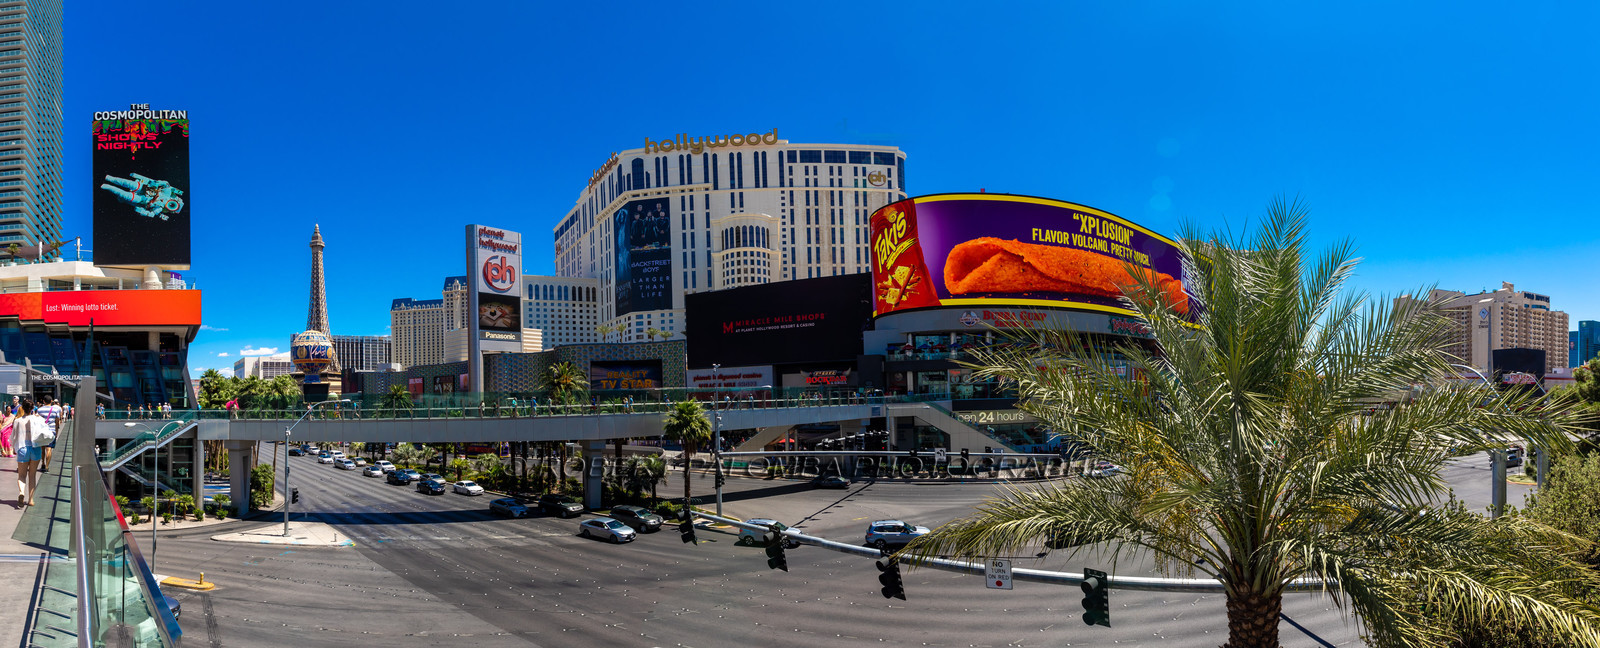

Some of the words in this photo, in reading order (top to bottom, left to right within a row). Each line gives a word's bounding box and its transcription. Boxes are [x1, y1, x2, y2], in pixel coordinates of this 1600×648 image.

[94, 110, 186, 121] COSMOPOLITAN
[98, 142, 163, 150] NIGHTLY
[644, 128, 778, 155] hollywood
[479, 227, 504, 237] planet
[479, 238, 517, 252] hollywood
[1032, 228, 1070, 245] FLAVOR
[1072, 233, 1110, 253] VOLCANO.
[1111, 243, 1132, 261] PRETTY
[632, 260, 672, 268] BACKSTREET
[487, 256, 515, 284] ph
[633, 276, 670, 284] LARGER
[61, 304, 84, 313] Winning
[100, 303, 119, 311] ticket.
[735, 317, 771, 327] MIRACLE
[774, 315, 793, 323] MILE
[796, 312, 825, 321] SHOPS
[982, 310, 1016, 321] BUBBA
[485, 331, 516, 340] Panasonic
[607, 370, 648, 379] REALITY
[600, 380, 617, 389] TV
[621, 379, 653, 389] STAR
[979, 411, 995, 423] 24
[997, 411, 1024, 421] hours
